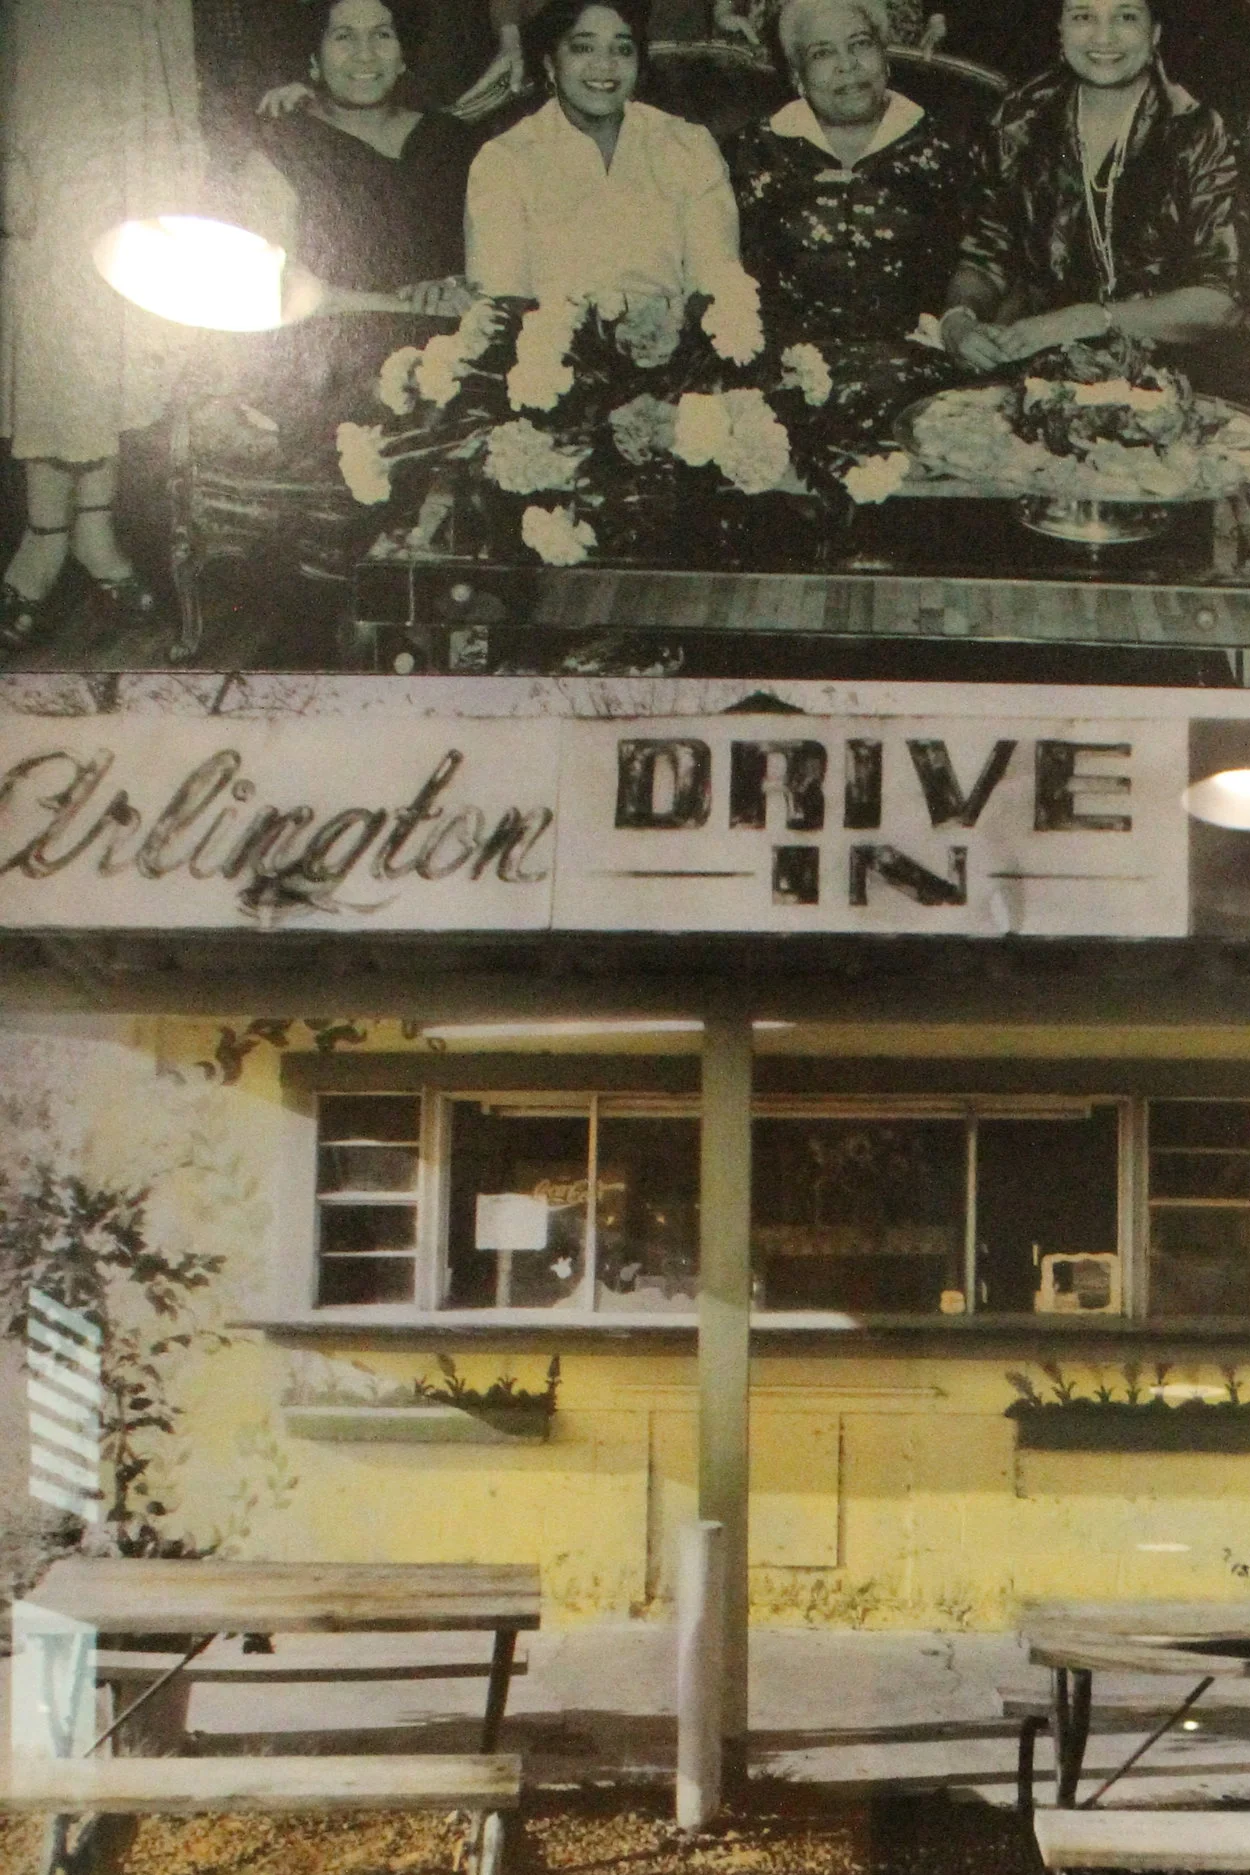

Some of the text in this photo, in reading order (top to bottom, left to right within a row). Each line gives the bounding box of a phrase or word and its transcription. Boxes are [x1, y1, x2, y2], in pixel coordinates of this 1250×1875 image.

[0, 738, 1132, 914] Arlington DRIVE
[772, 844, 968, 906] IN
